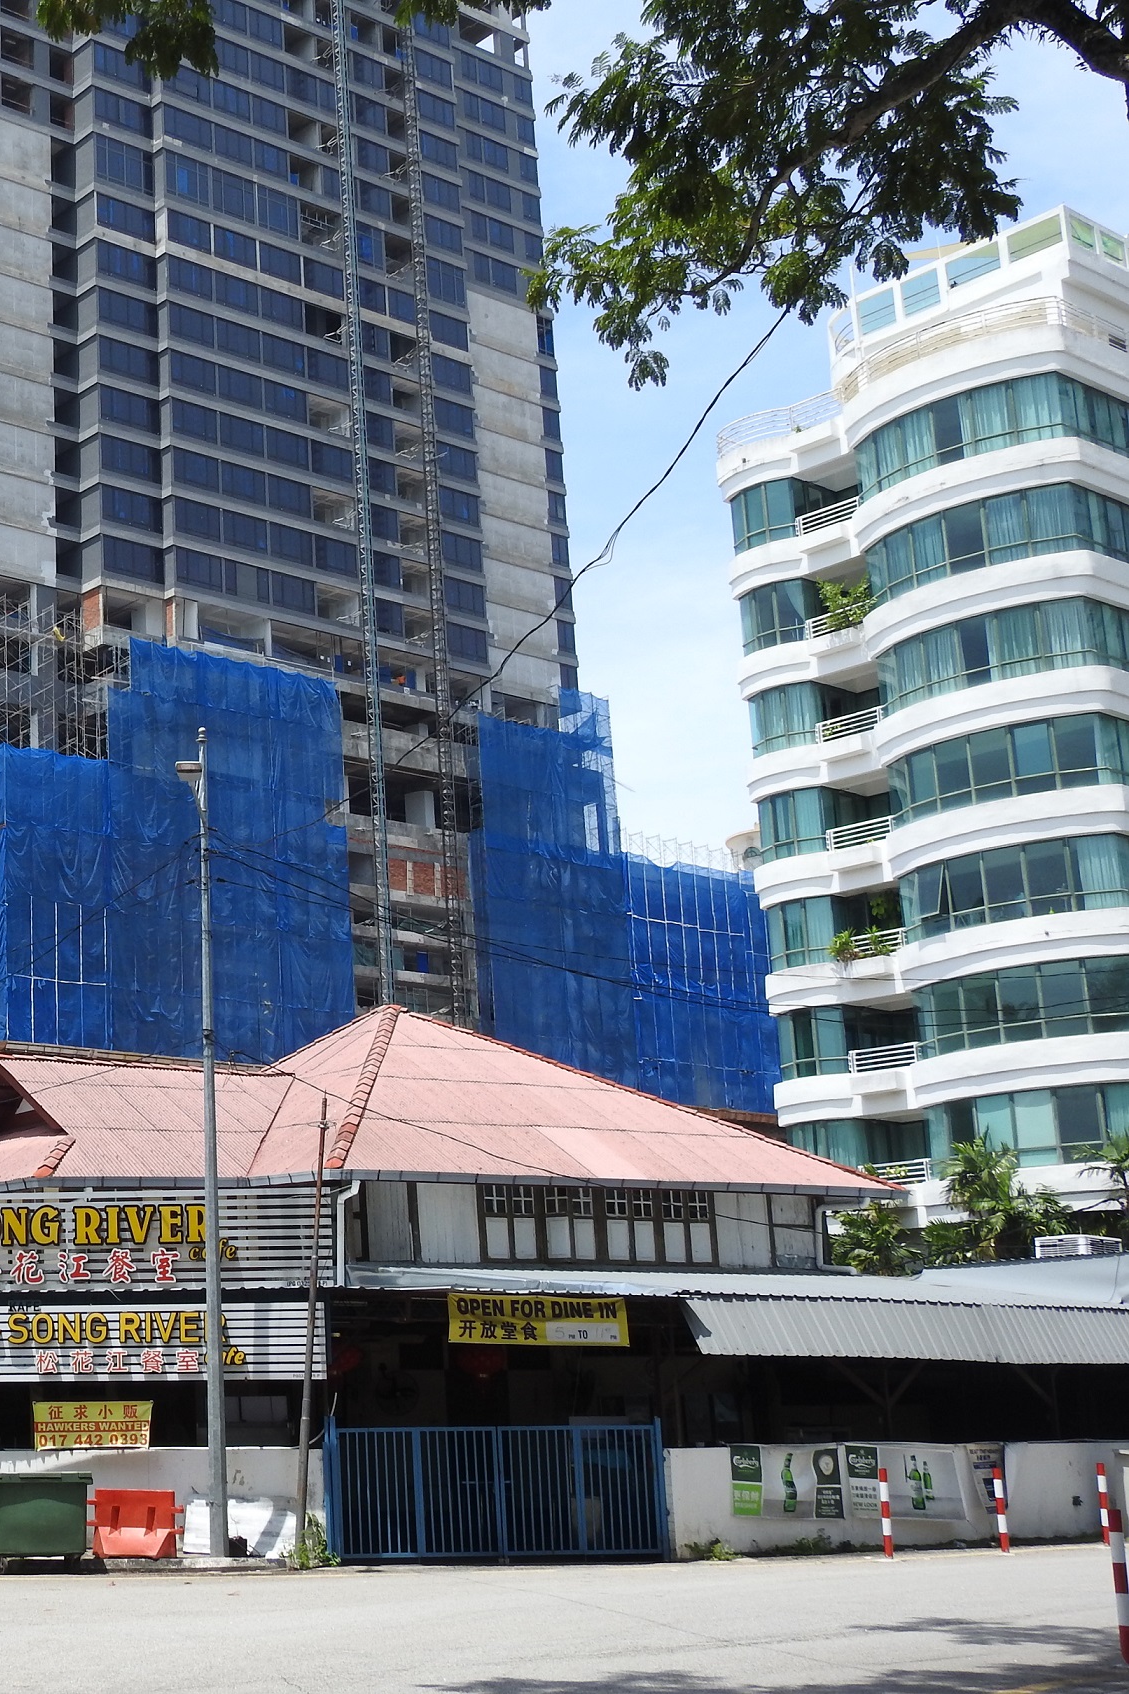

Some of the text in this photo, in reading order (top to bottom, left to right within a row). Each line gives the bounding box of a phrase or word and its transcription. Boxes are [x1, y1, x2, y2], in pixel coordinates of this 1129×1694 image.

[8, 1300, 41, 1312] KAFE
[456, 1298, 617, 1319] OPEN FOR DINE IN
[7, 1312, 109, 1345] SONG
[458, 1320, 538, 1341] 开放堂食
[555, 1326, 565, 1339] 5
[577, 1329, 588, 1340] TO
[36, 1350, 200, 1374] 松花江餐室
[48, 1404, 138, 1420] 征求小贩
[37, 1422, 150, 1432] HAWKERS WANTED
[38, 1433, 148, 1448] 017 442 0393
